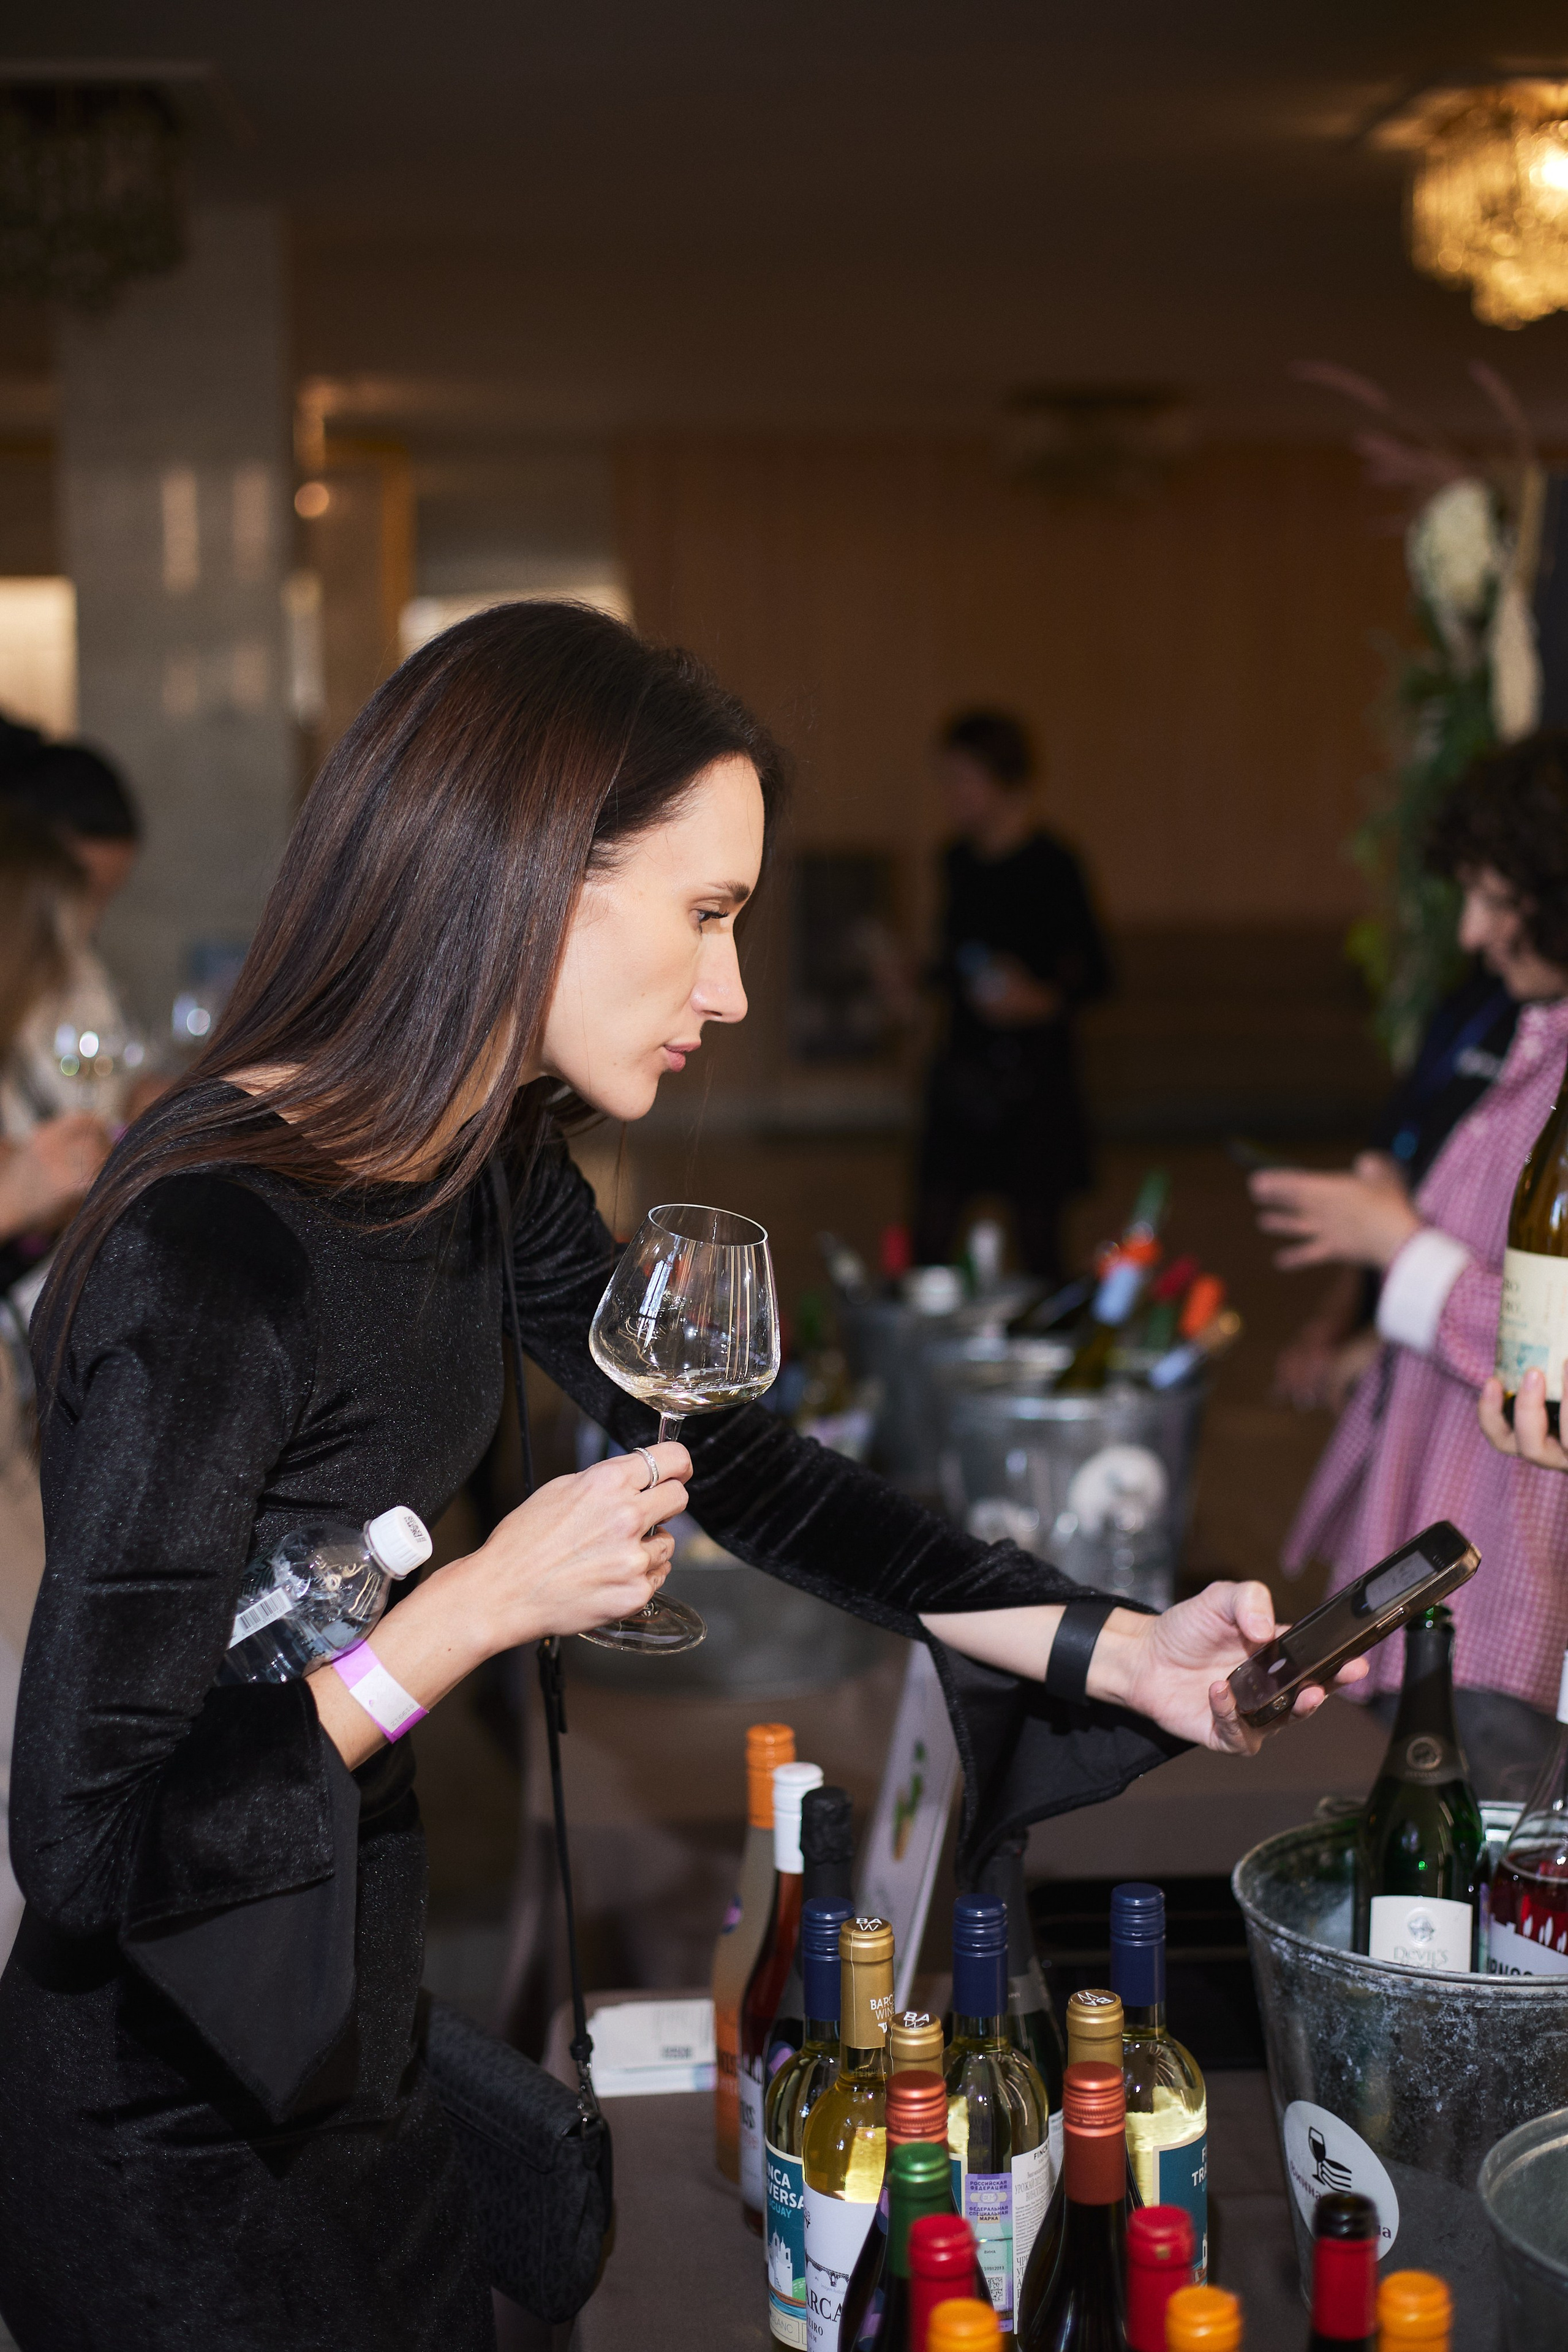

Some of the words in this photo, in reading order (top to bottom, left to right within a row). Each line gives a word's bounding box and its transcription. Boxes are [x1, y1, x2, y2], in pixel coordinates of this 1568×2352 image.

[903, 2011, 929, 2022] BA
[767, 2162, 791, 2189] NCA
[769, 2199, 792, 2218] GUAY
